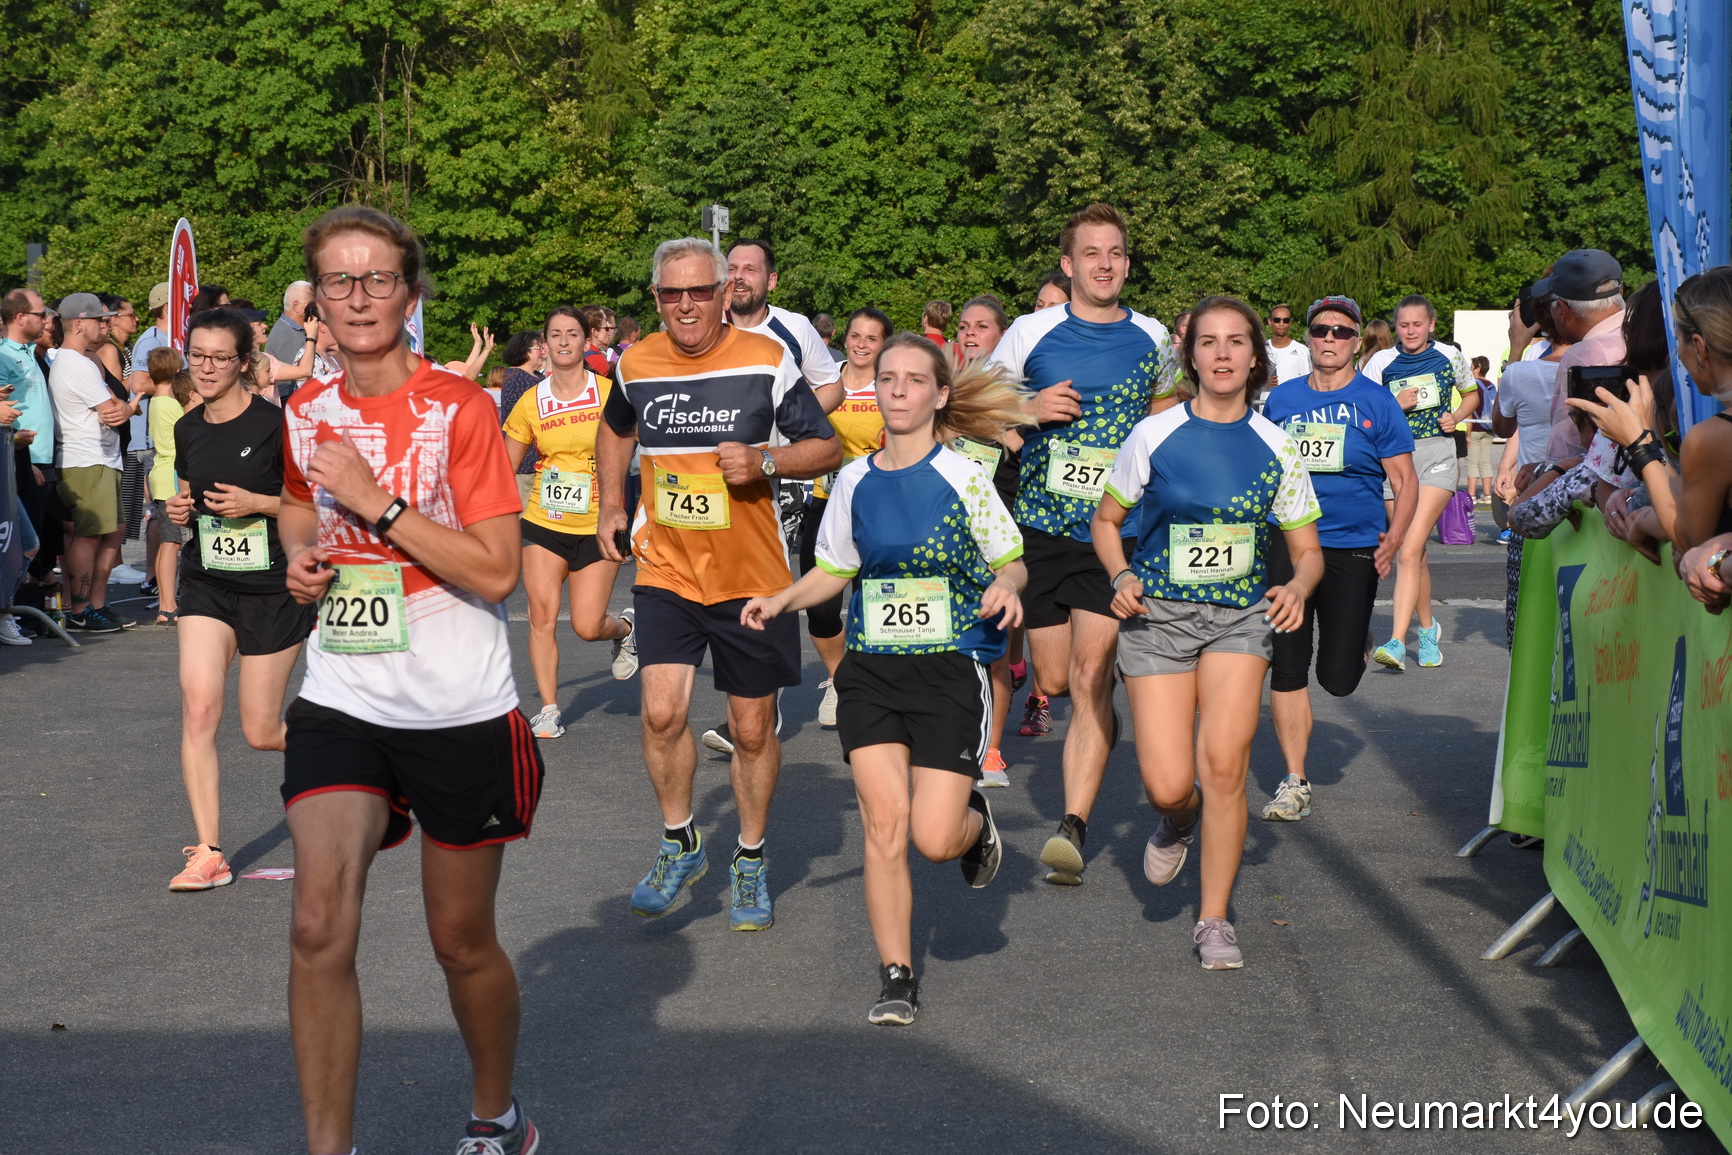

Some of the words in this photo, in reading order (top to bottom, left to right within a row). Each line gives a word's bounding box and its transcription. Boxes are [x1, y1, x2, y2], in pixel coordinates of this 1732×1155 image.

[540, 417, 567, 432] MAX
[657, 406, 741, 425] Fischer
[665, 424, 735, 434] AUTOMOBILE
[1062, 463, 1106, 486] 257
[545, 484, 583, 502] 1674
[1062, 481, 1081, 490] Pfister
[666, 491, 710, 515] 743
[669, 512, 691, 520] Fischer
[212, 536, 251, 556] 434
[1188, 546, 1233, 568] 221
[325, 596, 389, 627] 2220
[882, 603, 931, 627] 265
[331, 629, 348, 637] Meier
[349, 629, 378, 637] Andrea
[880, 627, 916, 635] Schmauser
[917, 626, 936, 635] Tanja
